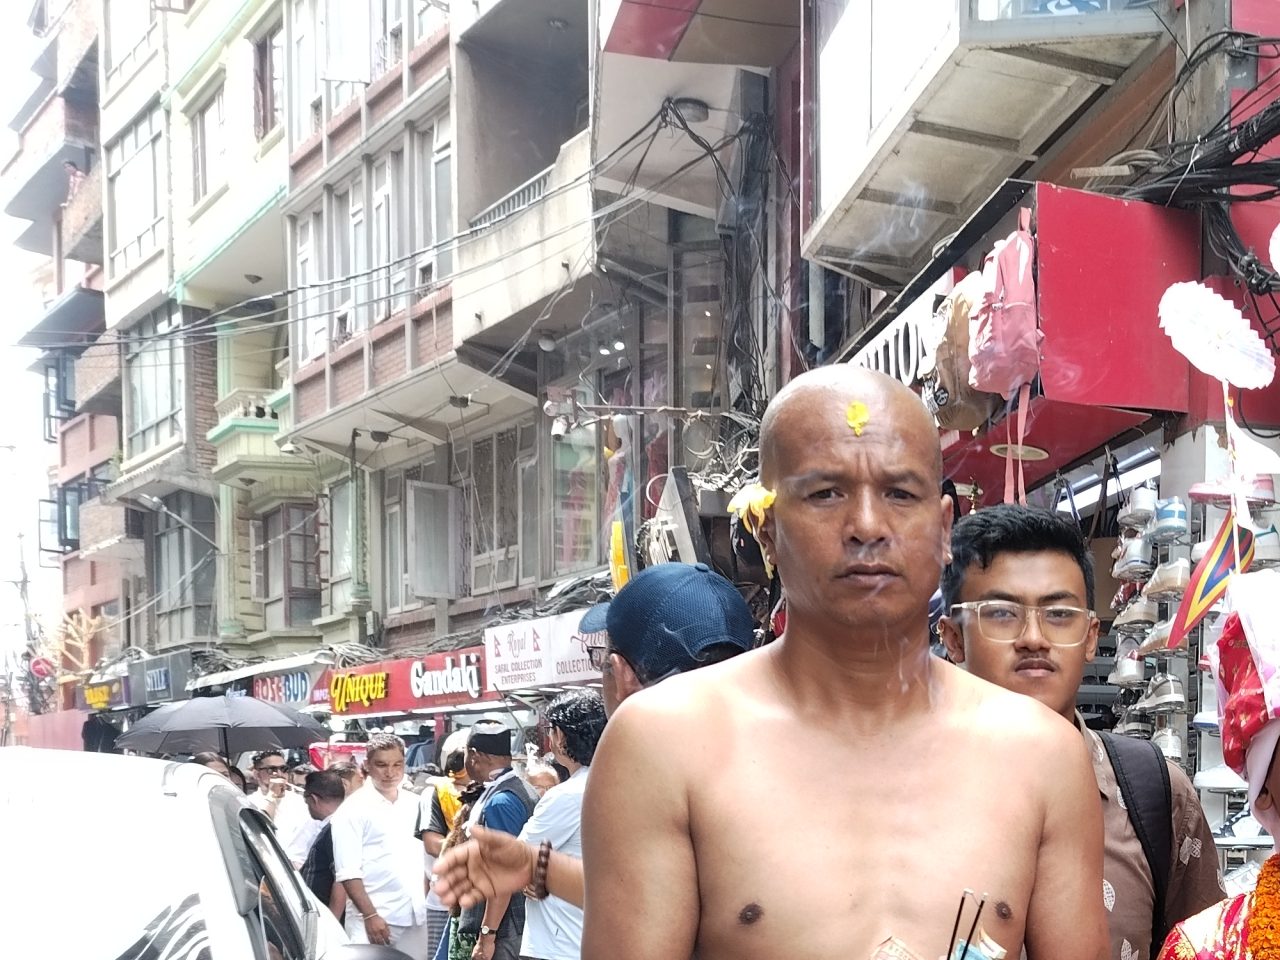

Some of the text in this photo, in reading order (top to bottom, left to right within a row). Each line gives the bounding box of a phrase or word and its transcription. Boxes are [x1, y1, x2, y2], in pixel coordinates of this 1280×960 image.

[410, 653, 479, 698] Gandaki
[501, 672, 536, 685] ENTERPRISES
[511, 659, 543, 672] COLLECTION
[331, 672, 386, 712] UNIQUE
